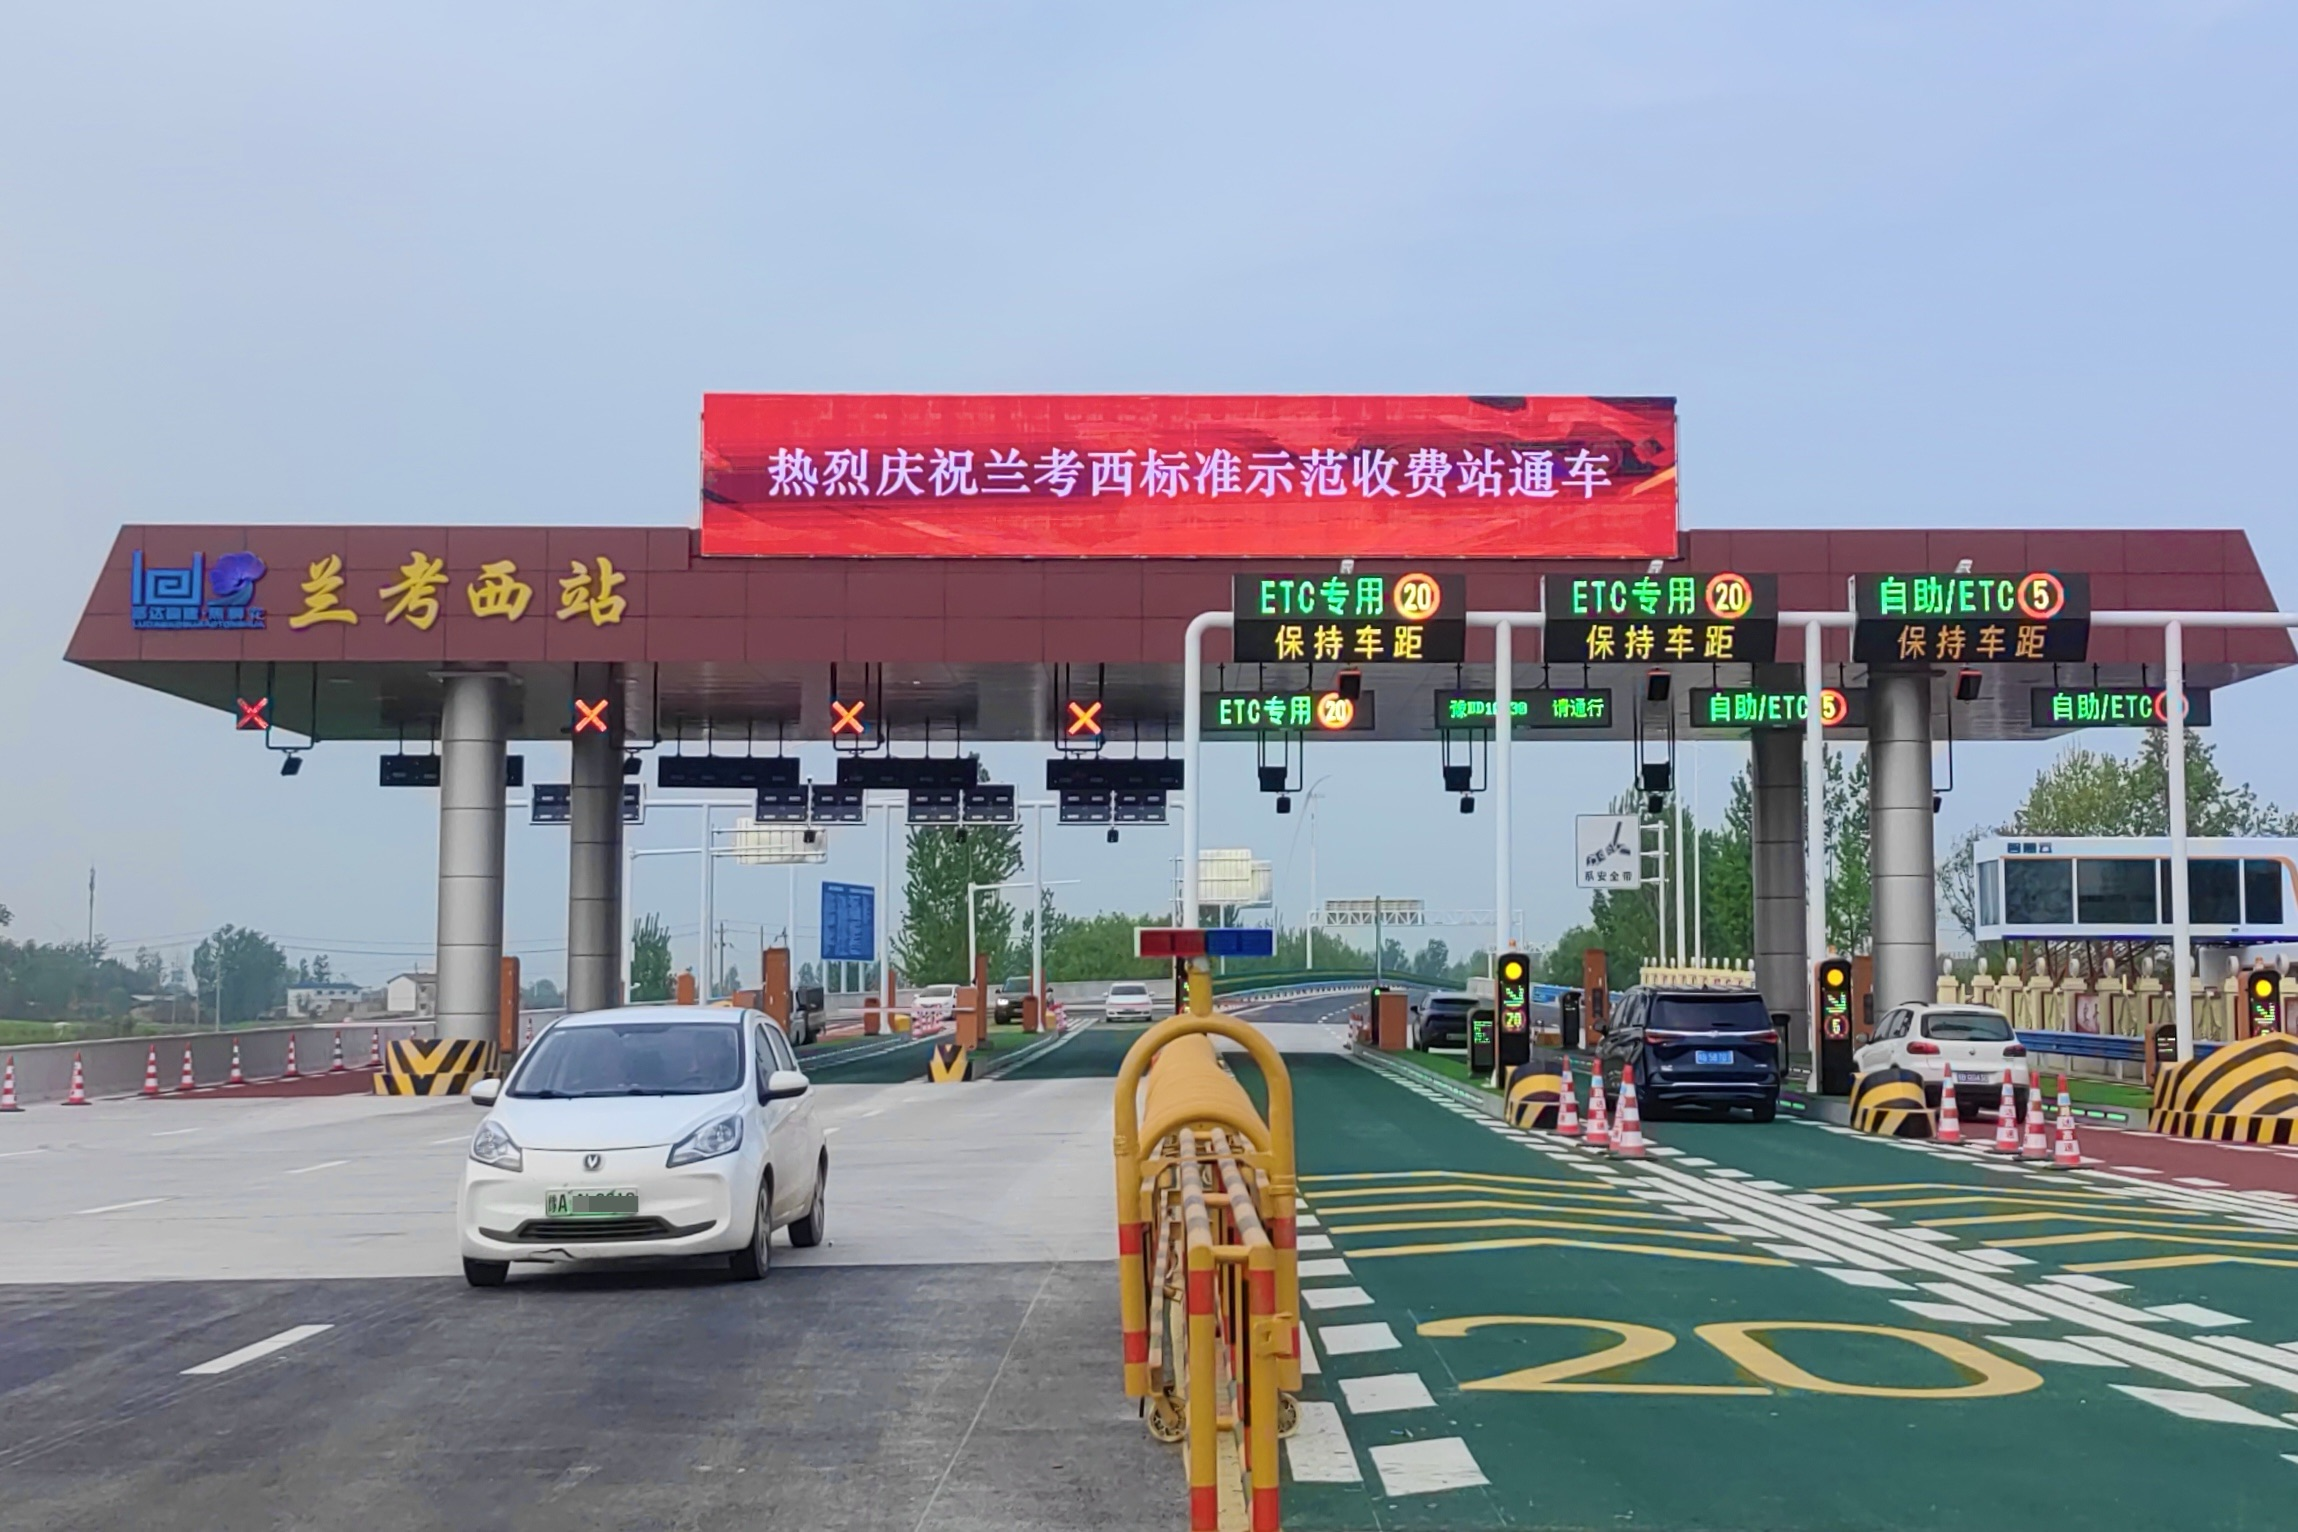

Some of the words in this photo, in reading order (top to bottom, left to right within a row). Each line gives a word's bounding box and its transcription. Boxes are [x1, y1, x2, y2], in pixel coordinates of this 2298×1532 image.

[768, 447, 1612, 498] 热烈庆祝兰考西标准示范收费站通车
[289, 551, 627, 630] 兰考西站
[1261, 576, 1384, 615] ETC专用
[1403, 582, 1432, 612] 20
[1573, 576, 1696, 615] ETC专用
[1715, 582, 1744, 611] 20
[1880, 576, 2015, 615] 自助/ETC
[2032, 580, 2050, 610] 5
[1275, 624, 1425, 660] 保持车距
[1586, 624, 1736, 660] 保持车距
[1897, 624, 2048, 660] 保持车距
[1219, 695, 1312, 725] ETC专用
[1325, 699, 1347, 722] 20
[1552, 698, 1605, 718] 请通行
[1710, 692, 1808, 722] 自助/ETC
[1822, 695, 1837, 719] 5
[2053, 692, 2153, 721] 自助/ETC
[1416, 1315, 2045, 1399] 20
